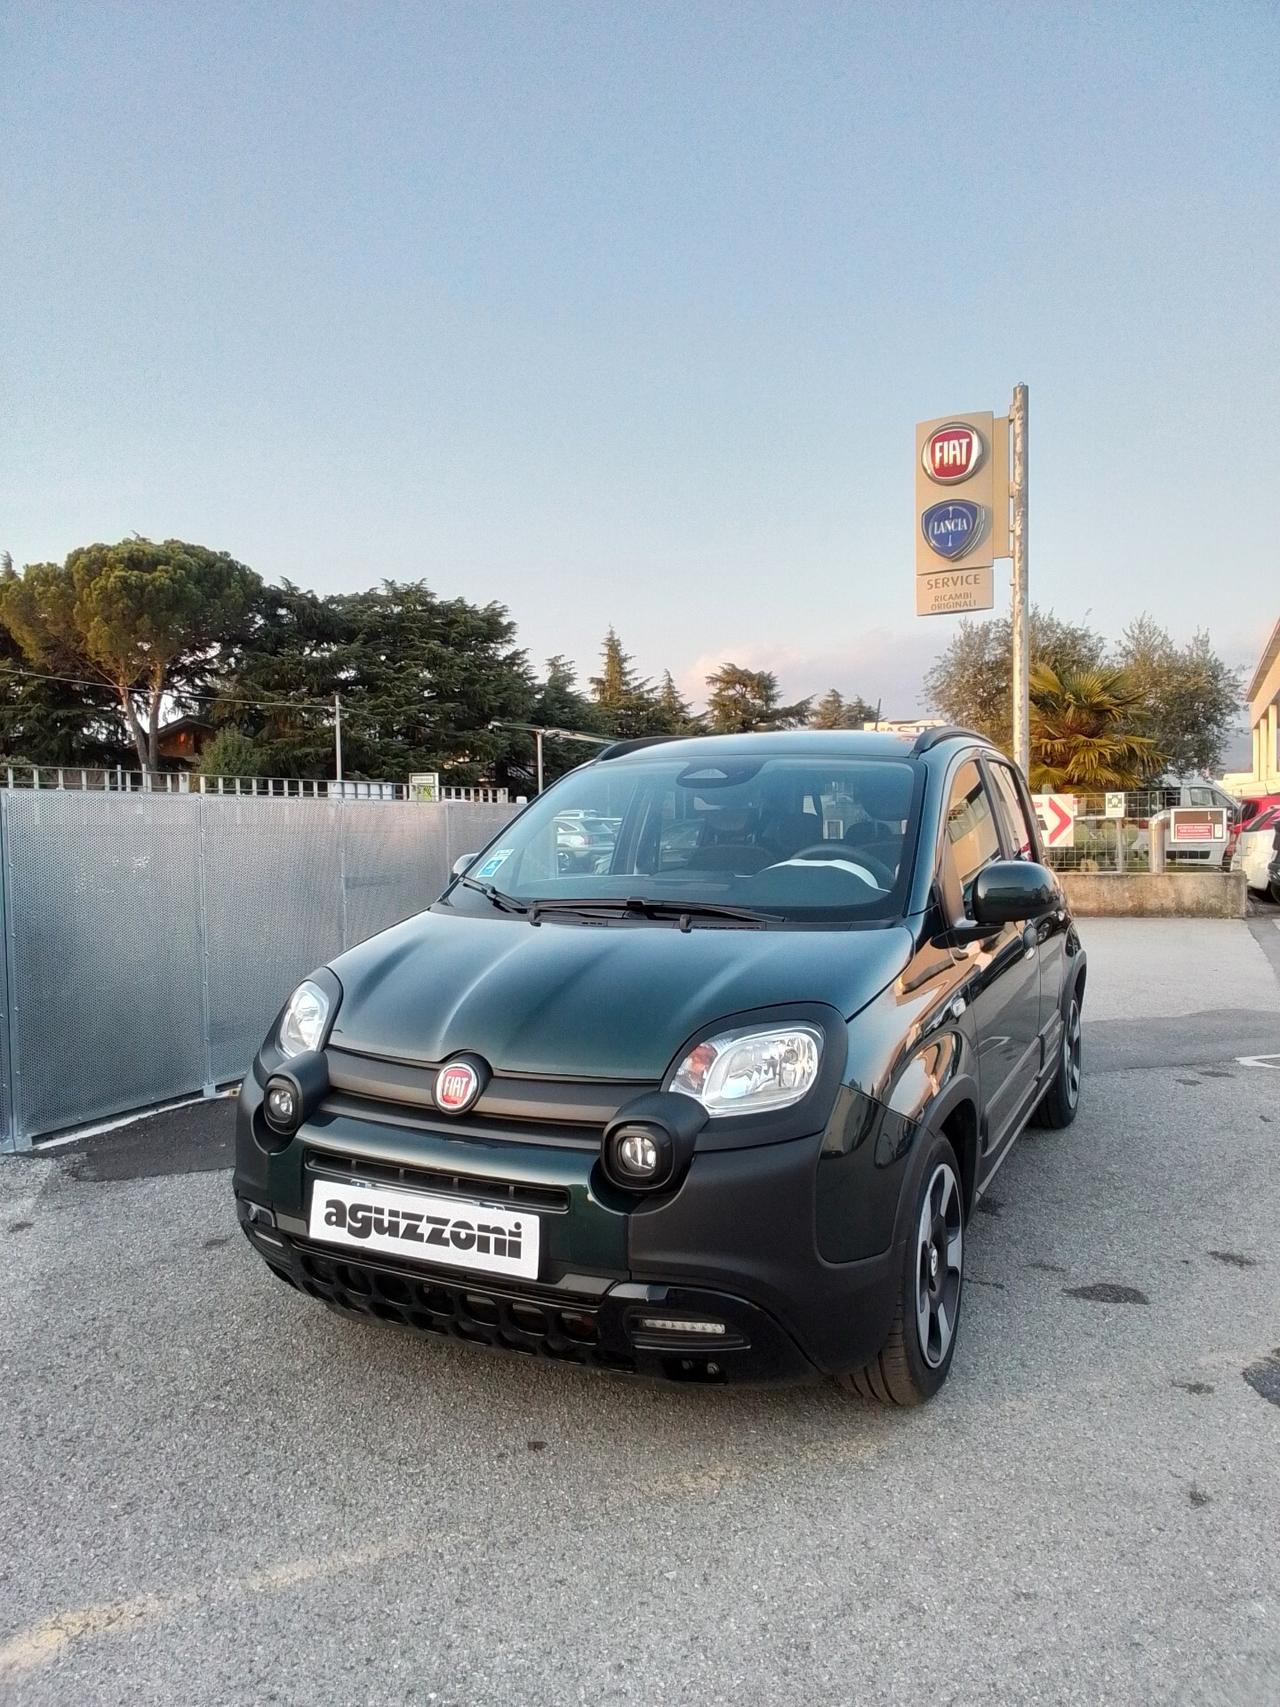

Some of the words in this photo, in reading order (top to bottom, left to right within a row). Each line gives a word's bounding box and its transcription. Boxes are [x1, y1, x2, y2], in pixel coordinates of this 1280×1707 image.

[935, 438, 970, 467] FIAT
[934, 518, 968, 535] LANCIA
[927, 574, 980, 590] SERVICE
[931, 601, 976, 611] ORIGINALI
[934, 592, 972, 603] RICAMBI
[443, 1076, 469, 1098] FIAT
[324, 1199, 522, 1259] aguzzoni
